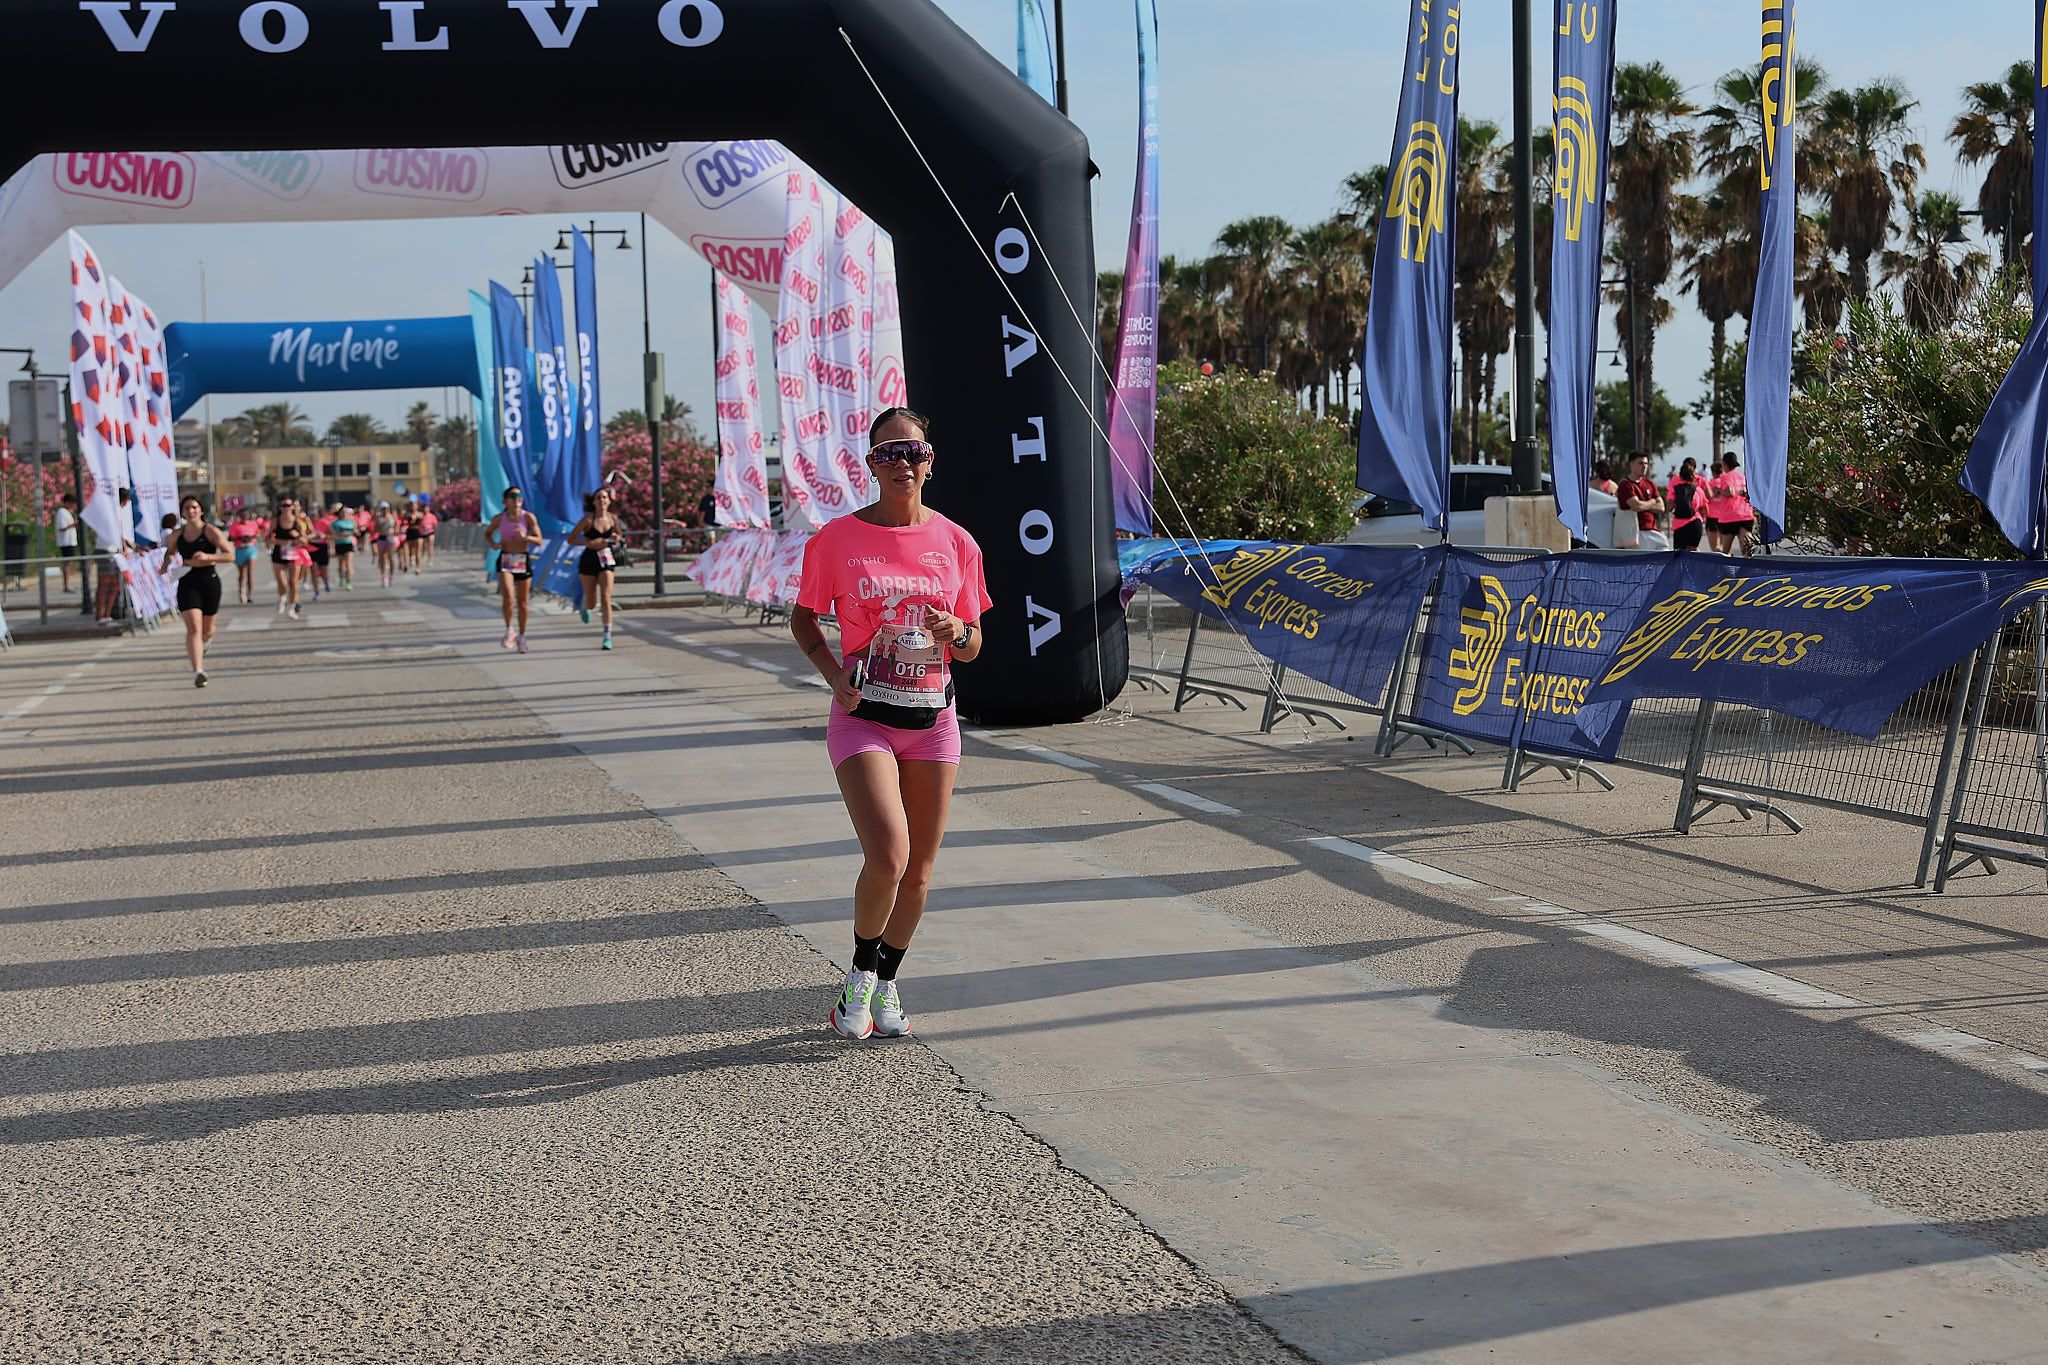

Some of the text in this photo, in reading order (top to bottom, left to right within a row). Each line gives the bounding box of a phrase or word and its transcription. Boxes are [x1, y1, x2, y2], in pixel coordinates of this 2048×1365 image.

[79, 0, 725, 53] VOLVO
[67, 152, 183, 201] COSMO
[366, 149, 478, 195] COSMO
[702, 242, 785, 284] COSM
[269, 326, 400, 383] Marlene
[994, 226, 1063, 657] VOLVO
[847, 556, 886, 567] OYSHO
[1285, 556, 1374, 600] Correos
[858, 575, 944, 600] CARRERA
[1244, 578, 1326, 640] Express
[1733, 577, 1893, 612] Correos
[1514, 594, 1606, 649] Correos
[1668, 617, 1825, 672] Express
[895, 662, 926, 678] 016
[1501, 657, 1590, 724] Express
[871, 689, 900, 701] OYSHO
